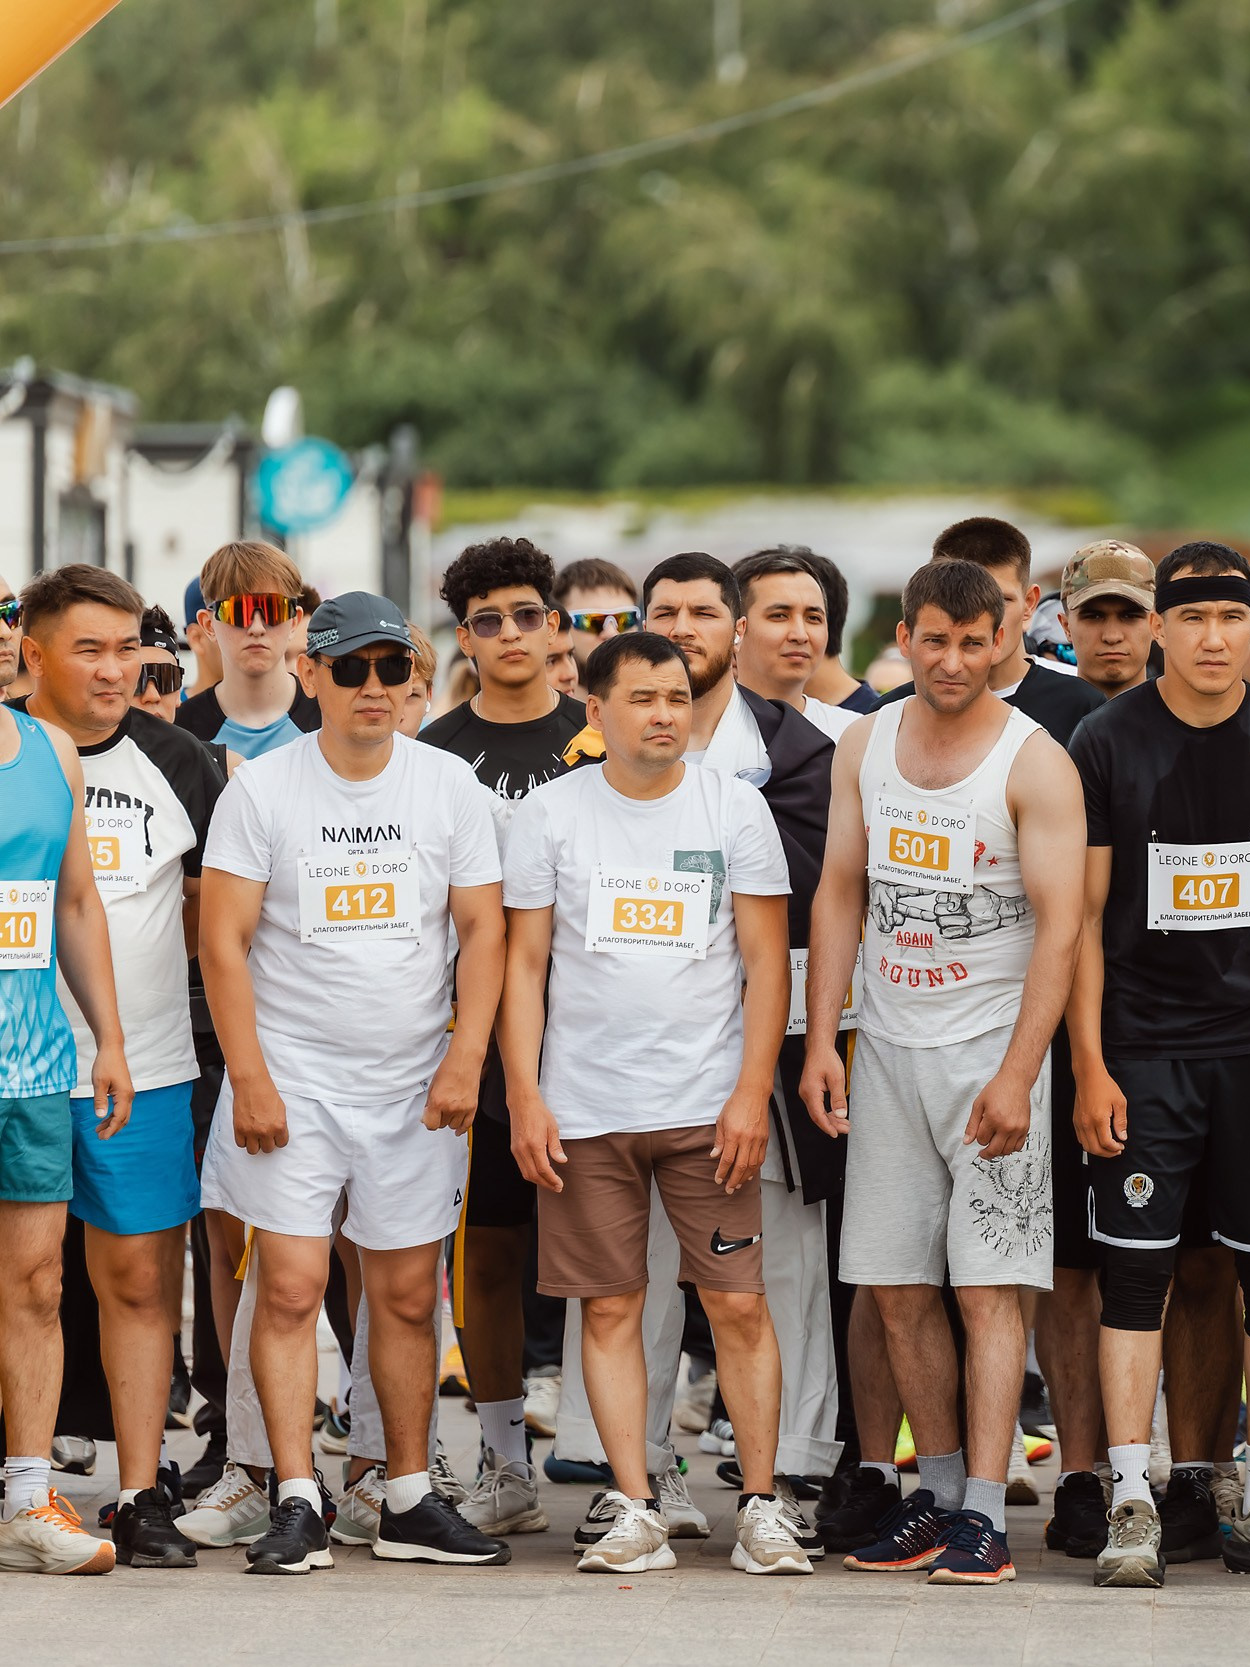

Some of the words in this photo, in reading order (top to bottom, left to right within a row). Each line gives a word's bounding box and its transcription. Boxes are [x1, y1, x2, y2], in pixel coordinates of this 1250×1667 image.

[97, 818, 133, 829] D'ORO
[880, 805, 913, 822] LEONE
[931, 815, 966, 830] D'ORO
[321, 824, 402, 843] NAIMAN
[894, 833, 941, 865] 501
[1159, 855, 1199, 866] LEONE
[308, 866, 350, 878] LEONE
[372, 862, 408, 875] D'ORO
[877, 863, 941, 881] БЛАГОТВОРИТЕЛЬНЫЙ
[942, 876, 962, 884] ЗАБЕГ
[600, 878, 641, 890] LEONE
[664, 881, 701, 893] D'ORO
[1178, 878, 1233, 906] 407
[22, 892, 47, 903] D'ORO
[331, 887, 389, 916] 412
[620, 902, 677, 931] 334
[1160, 912, 1233, 921] БЛАГОТВОРИТЕЛЬНЫЙ
[0, 916, 32, 944] 10
[312, 922, 389, 934] БЛАГОТВОРИТЕЛЬНЫЙ
[390, 921, 410, 929] ЗАБЕГ
[597, 936, 674, 947] БЛАГОТВОРИТЕЛЬНЫЙ
[675, 941, 695, 949] ЗАБЕГ
[896, 930, 933, 947] AGAIN
[879, 955, 968, 987] ROUND
